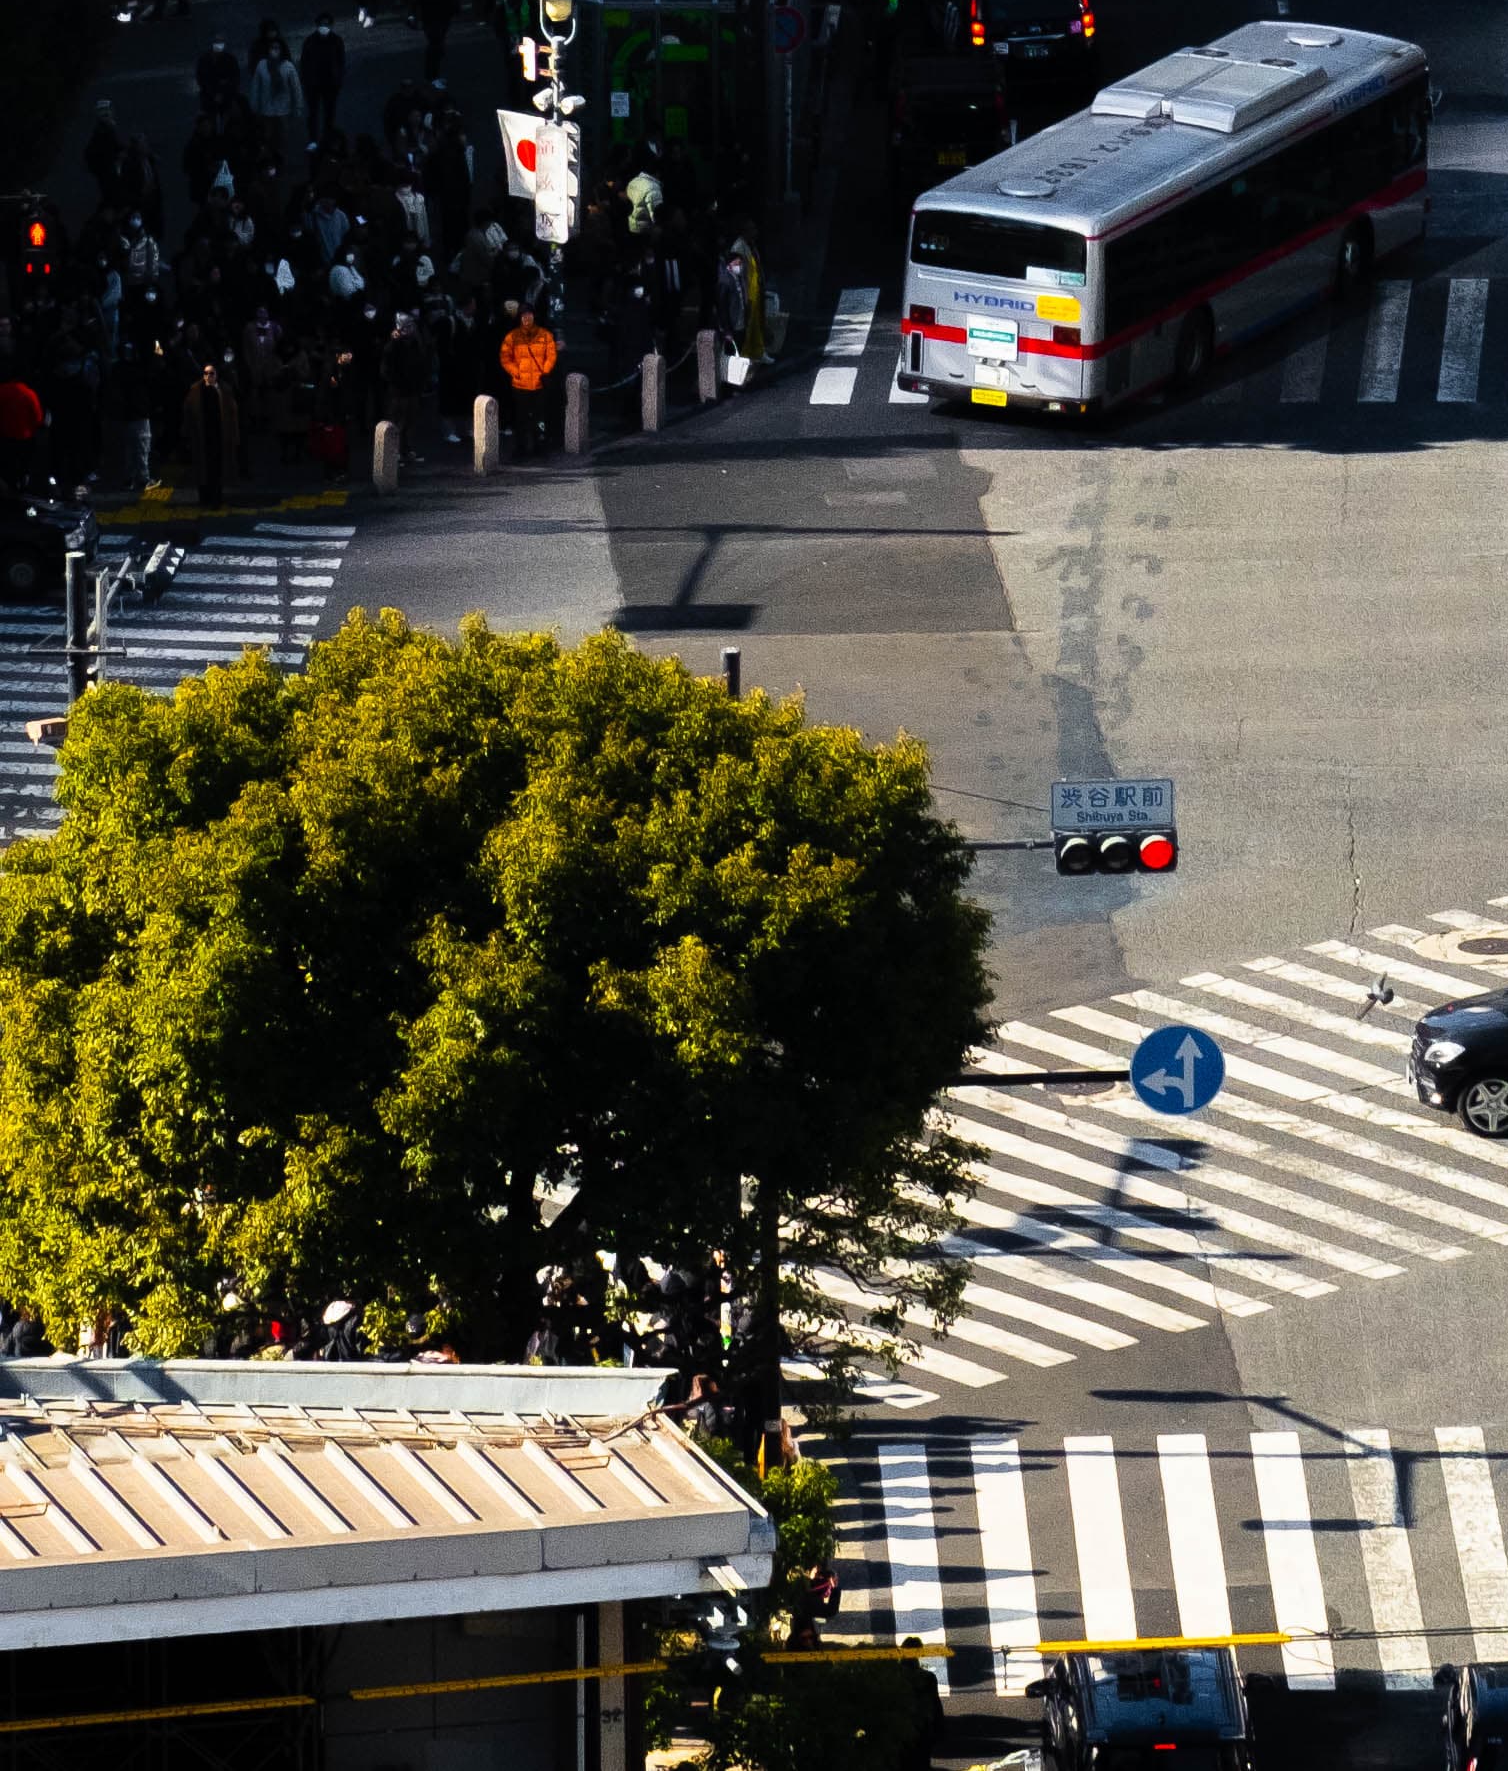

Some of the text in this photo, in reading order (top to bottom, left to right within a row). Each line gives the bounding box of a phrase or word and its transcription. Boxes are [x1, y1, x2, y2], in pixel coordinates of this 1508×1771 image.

[954, 291, 1035, 311] HYBRID
[1061, 786, 1163, 809] 渋谷駅前
[1077, 810, 1124, 824] Shibuya
